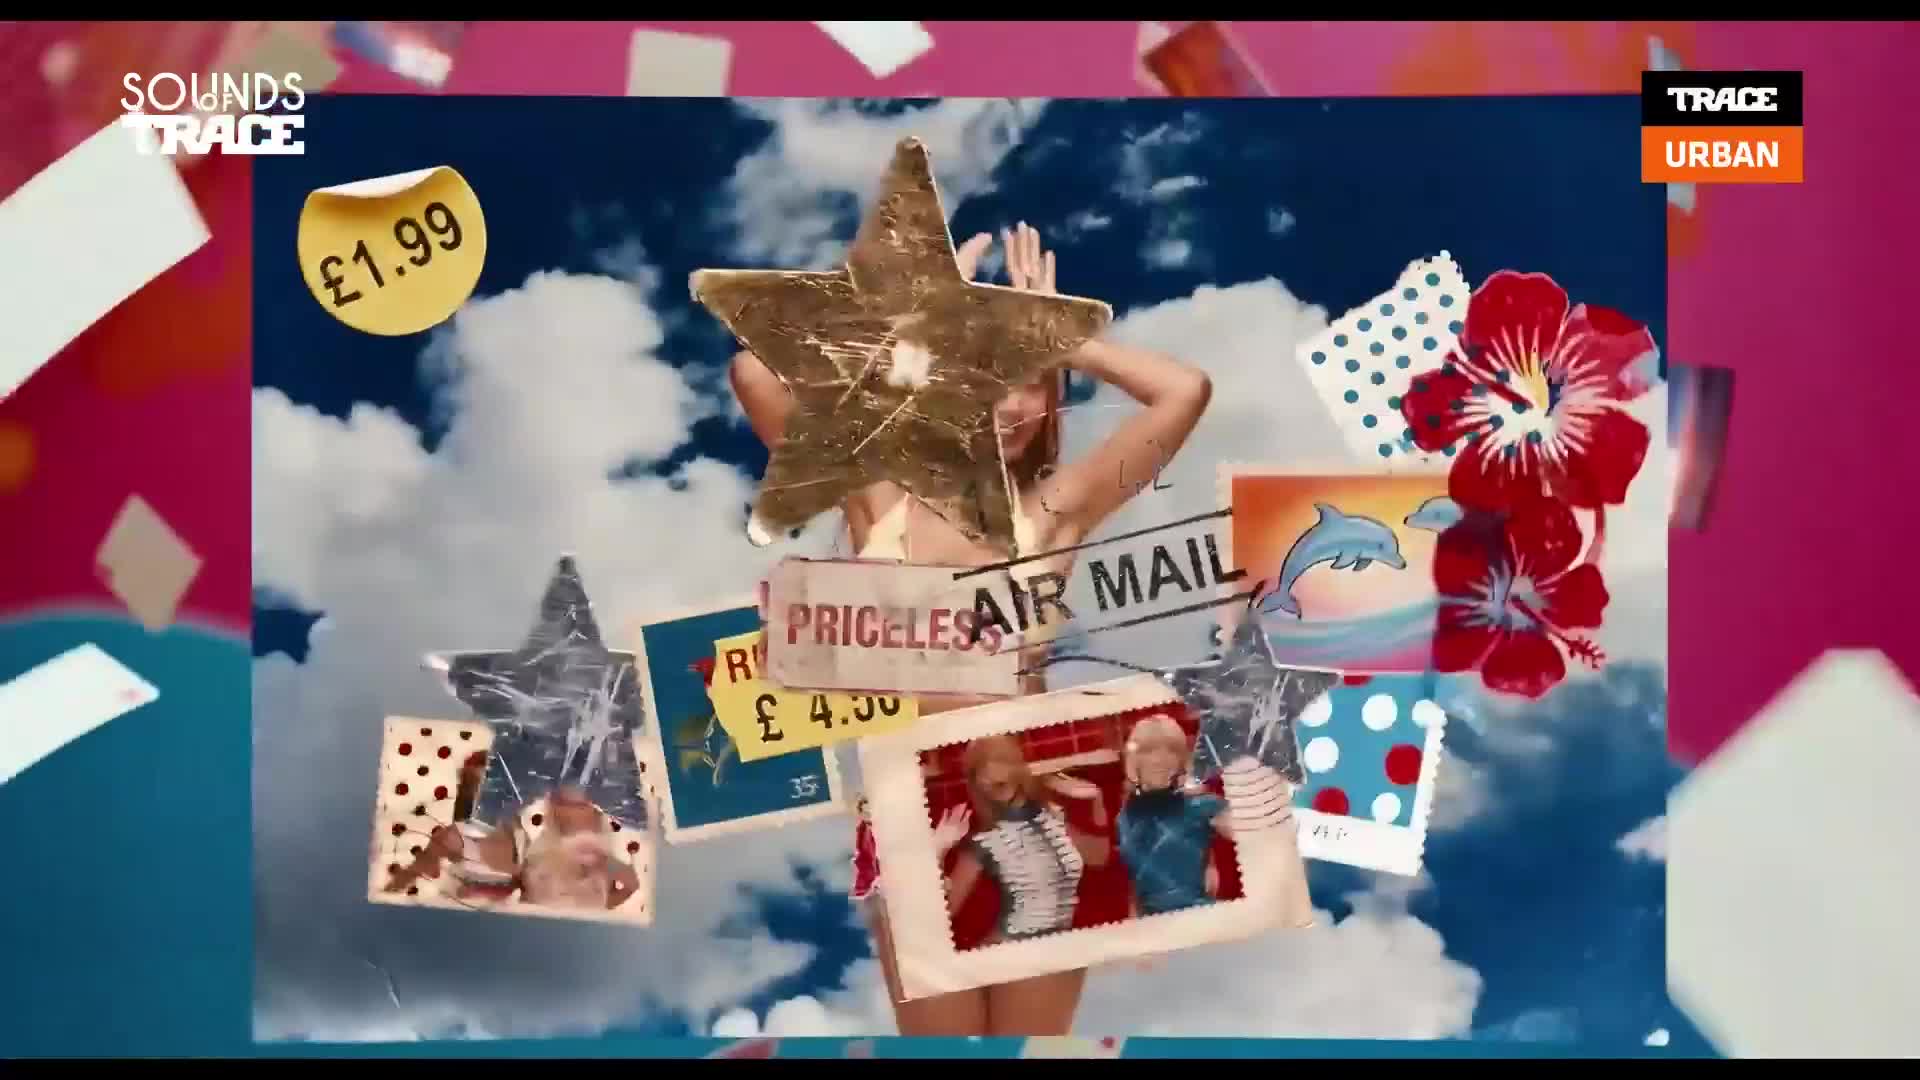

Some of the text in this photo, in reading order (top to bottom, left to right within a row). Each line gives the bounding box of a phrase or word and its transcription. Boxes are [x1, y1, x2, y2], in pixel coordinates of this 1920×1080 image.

[319, 201, 462, 307] £1.99
[786, 603, 1002, 651] PRICELESS
[970, 534, 1248, 643] AIR MAIL
